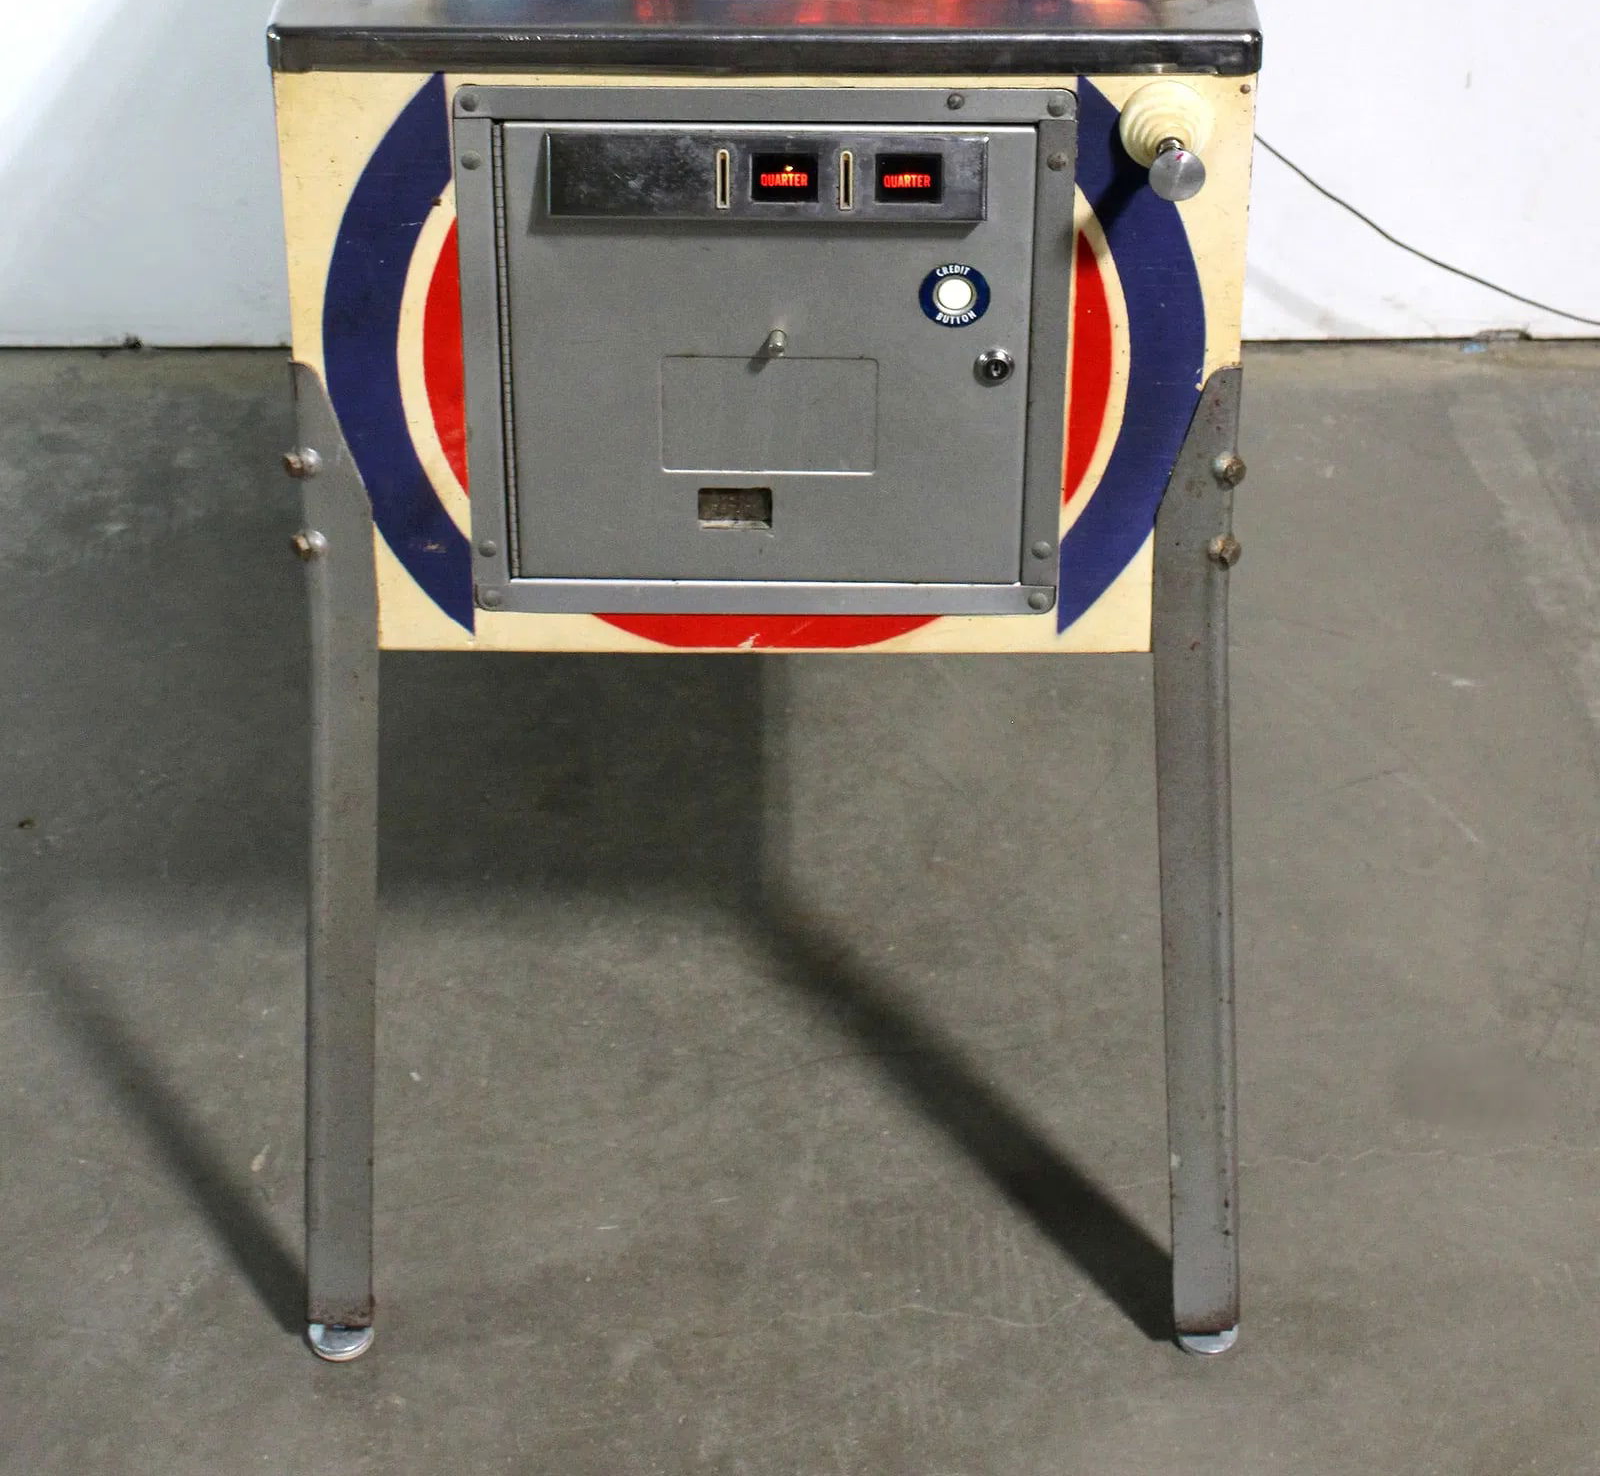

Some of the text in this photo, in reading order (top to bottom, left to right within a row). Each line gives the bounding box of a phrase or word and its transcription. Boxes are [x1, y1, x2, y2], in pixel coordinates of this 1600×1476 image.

[760, 171, 809, 187] QUARTER
[882, 173, 932, 189] QUARTER
[936, 264, 971, 277] CREDIT
[935, 309, 977, 325] BUTTON
